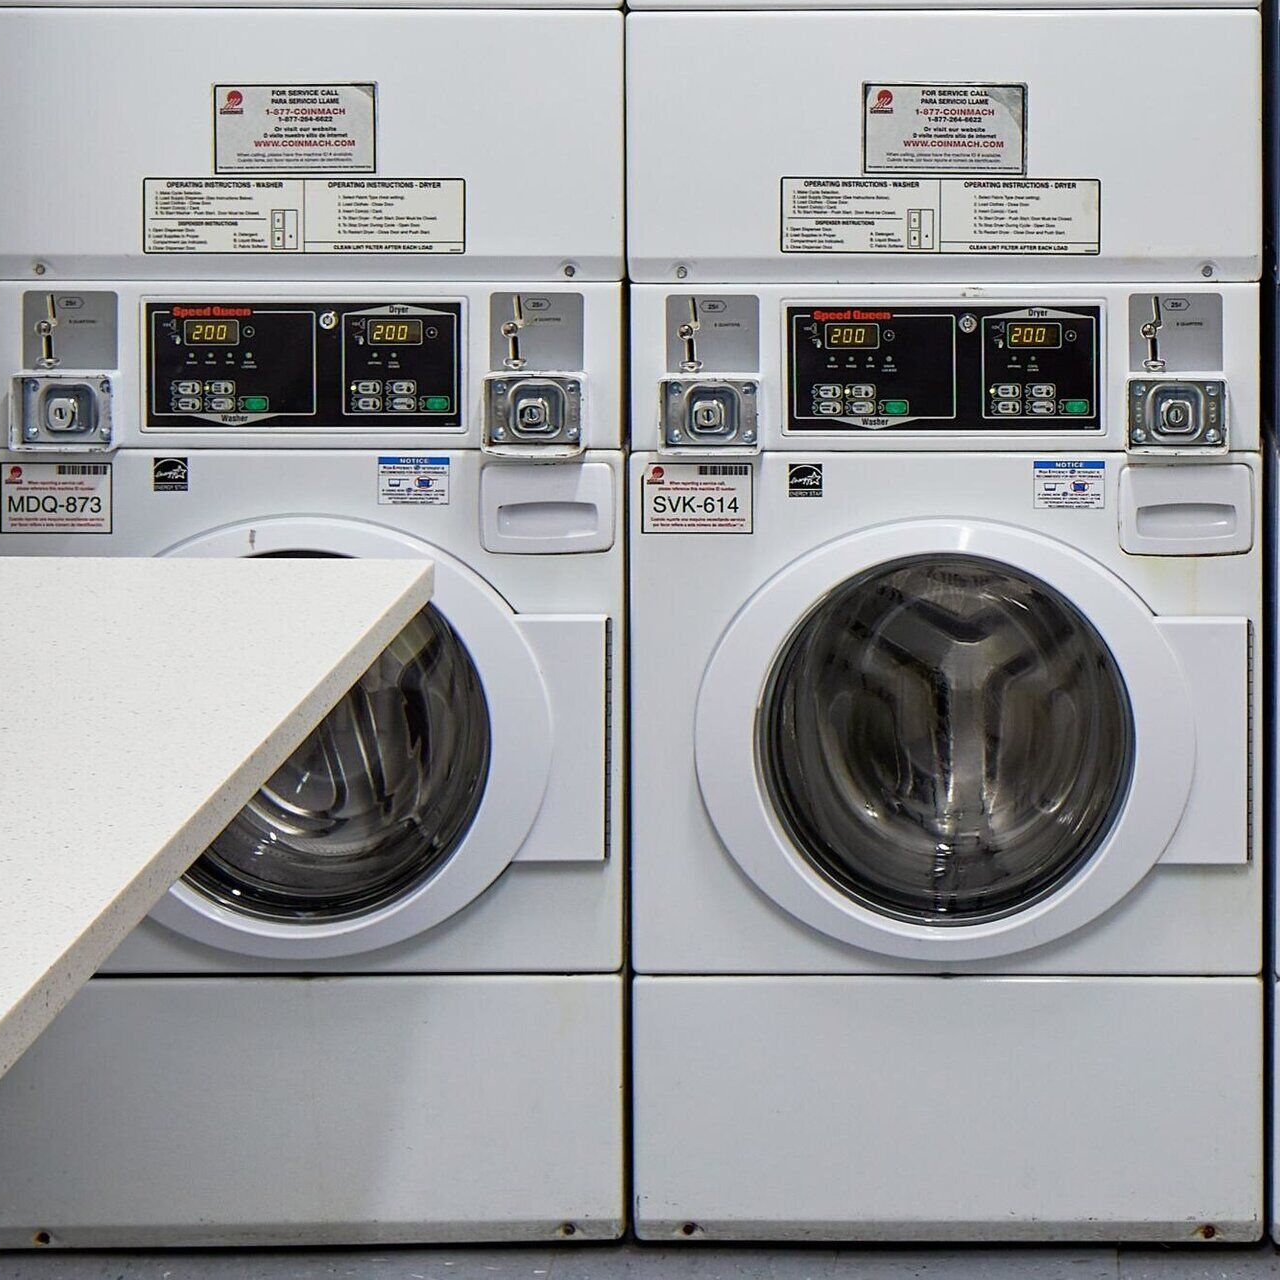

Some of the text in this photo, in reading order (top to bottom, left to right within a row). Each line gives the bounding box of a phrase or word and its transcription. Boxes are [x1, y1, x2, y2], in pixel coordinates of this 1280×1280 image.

[915, 108, 995, 116] 1-877-COINMACH
[903, 140, 1004, 148] WWW.COINMACH.COM
[173, 307, 251, 317] Speed Queen
[389, 306, 409, 314] Dryer
[813, 310, 891, 321] Speed Queen
[1028, 309, 1048, 317] Dryer
[192, 325, 226, 340] 200
[373, 325, 408, 340] 200
[831, 328, 865, 343] 200
[1011, 328, 1046, 342] 200
[862, 418, 888, 426] Washer
[8, 495, 101, 513] MDQ-873
[653, 495, 739, 513] SVK-614
